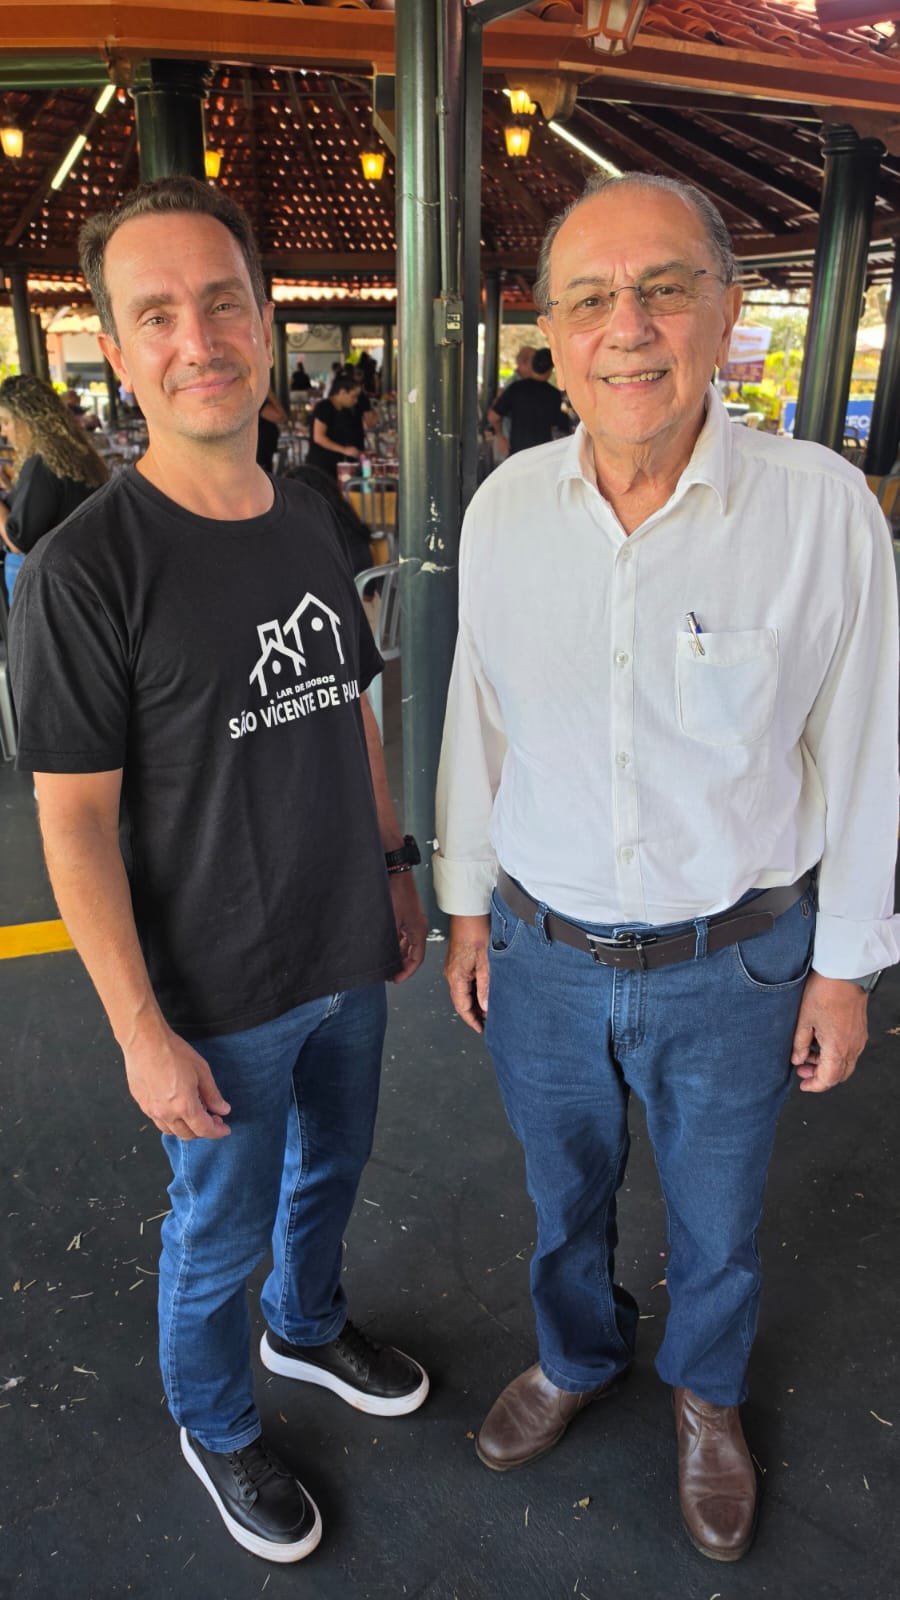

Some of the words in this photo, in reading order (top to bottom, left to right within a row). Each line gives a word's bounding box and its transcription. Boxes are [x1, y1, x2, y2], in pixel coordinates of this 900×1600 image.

[276, 687, 293, 699] LAR
[294, 682, 305, 693] DE
[305, 674, 336, 689] IDOSOS
[260, 699, 317, 728] VICENTE
[316, 686, 341, 709] DE
